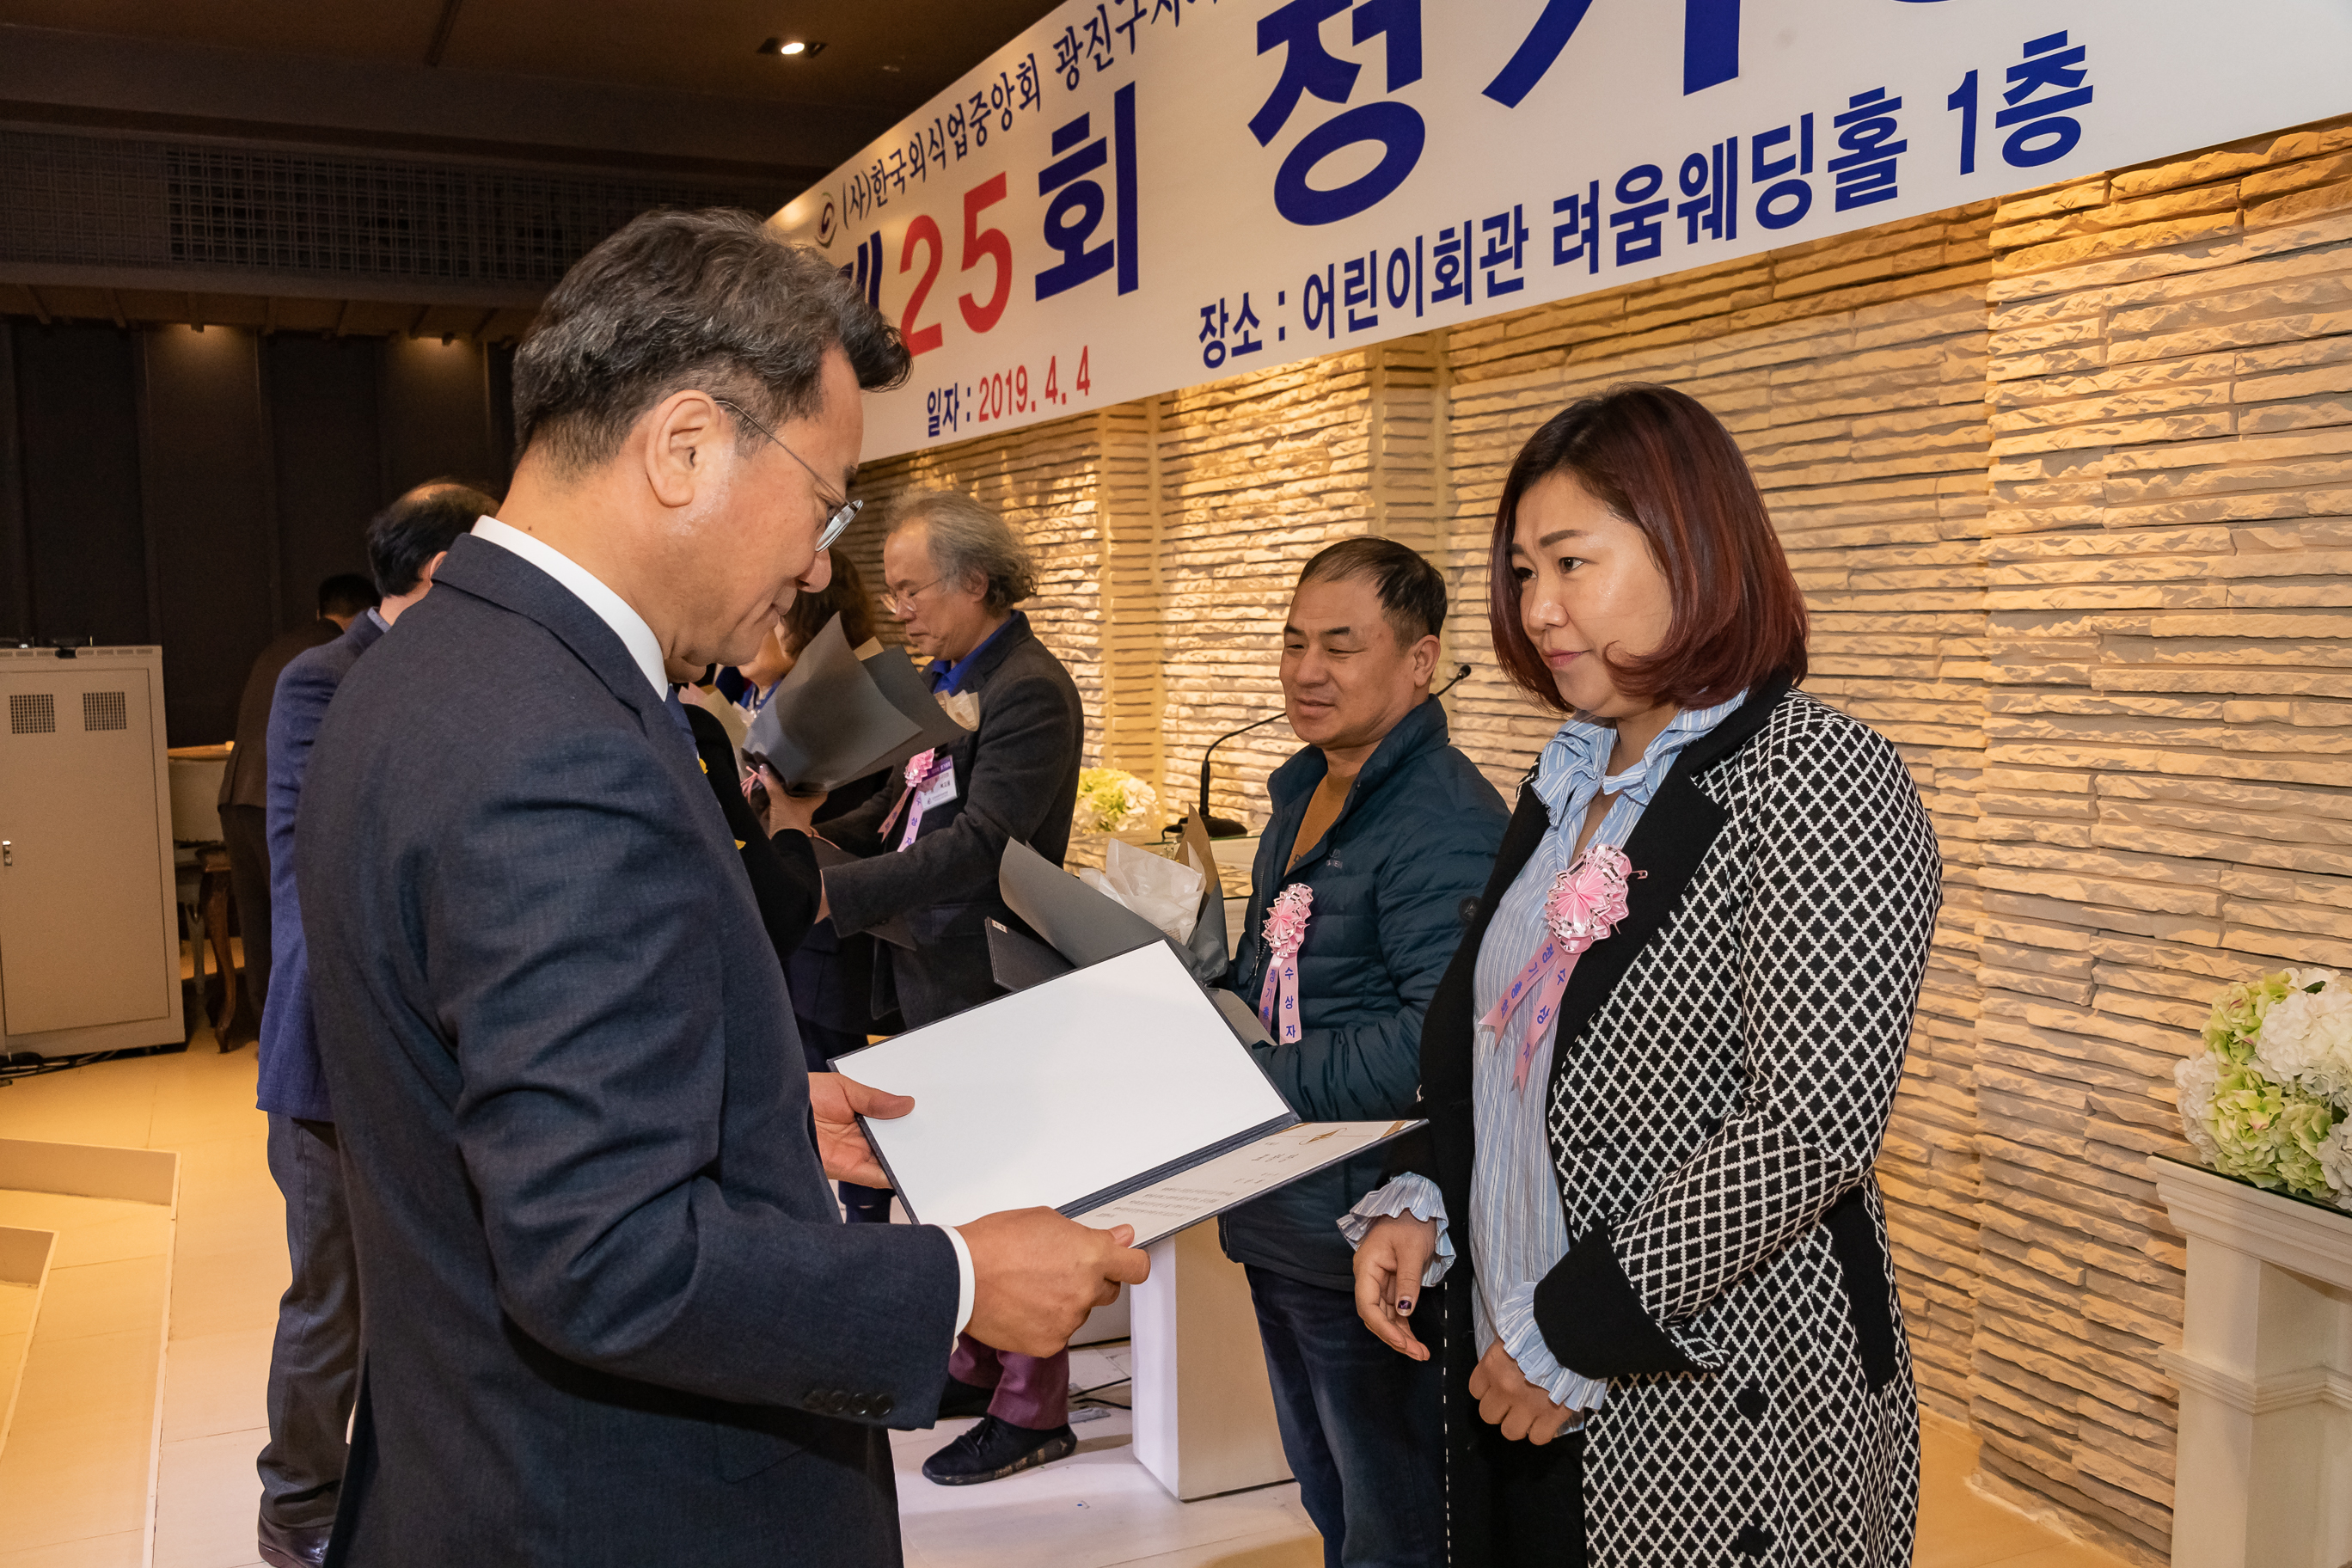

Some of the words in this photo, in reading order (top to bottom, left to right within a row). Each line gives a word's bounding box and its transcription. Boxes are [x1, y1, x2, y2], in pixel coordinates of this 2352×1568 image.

[1198, 291, 1264, 370] 장소
[1302, 203, 1530, 340] 어린이회관
[1553, 85, 1908, 276] 려움웨딩홀
[1946, 28, 2095, 177] 1층
[927, 382, 960, 438] 일자
